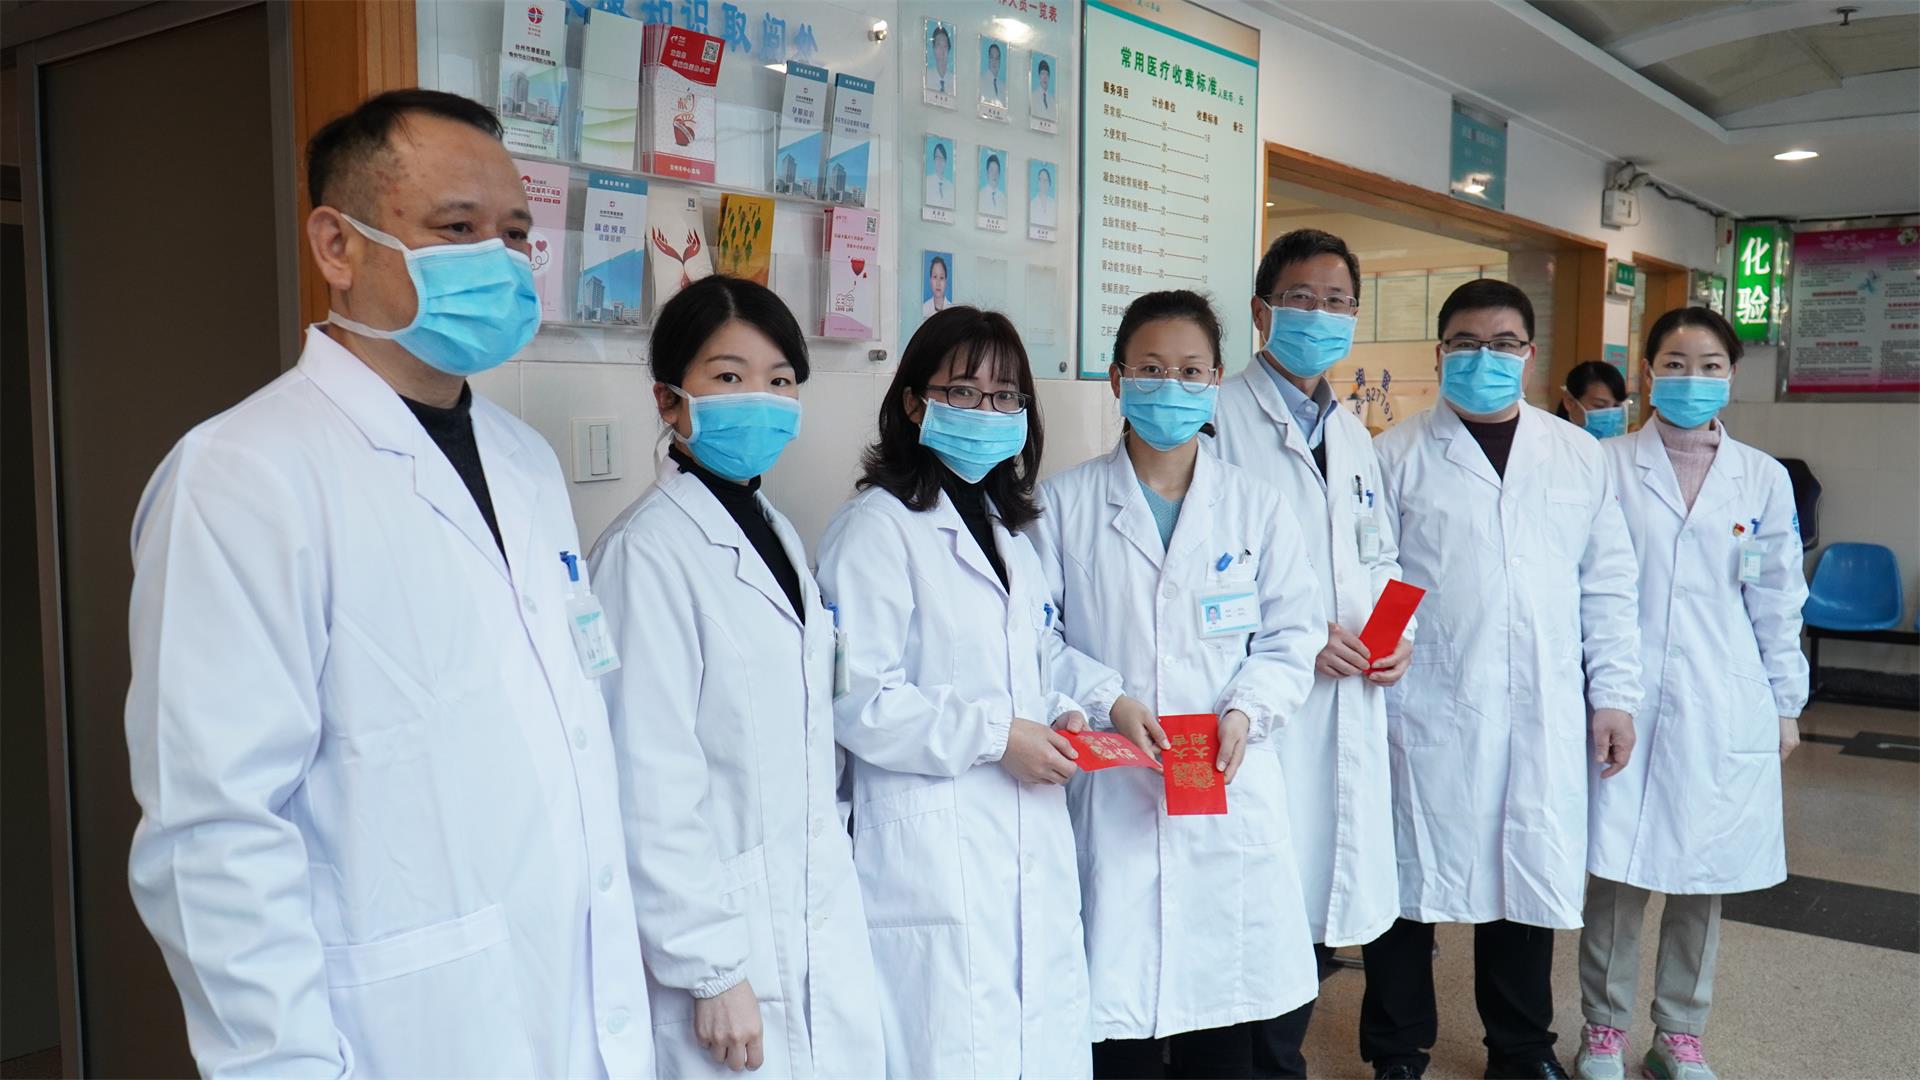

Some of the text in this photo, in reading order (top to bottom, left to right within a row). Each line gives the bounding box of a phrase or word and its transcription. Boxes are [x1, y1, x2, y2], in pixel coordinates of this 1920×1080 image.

[1120, 46, 1217, 96] 常用医疗收费标准
[1102, 80, 1129, 100] 服务项目
[1151, 96, 1177, 113] 计价单位
[1196, 109, 1219, 126] 收费标准
[1103, 104, 1122, 119] 尿常规
[1103, 128, 1127, 142] 大便常规
[1103, 150, 1121, 163] 血常规
[1737, 237, 1771, 325] 化验
[1101, 304, 1129, 315] 甲状腺功
